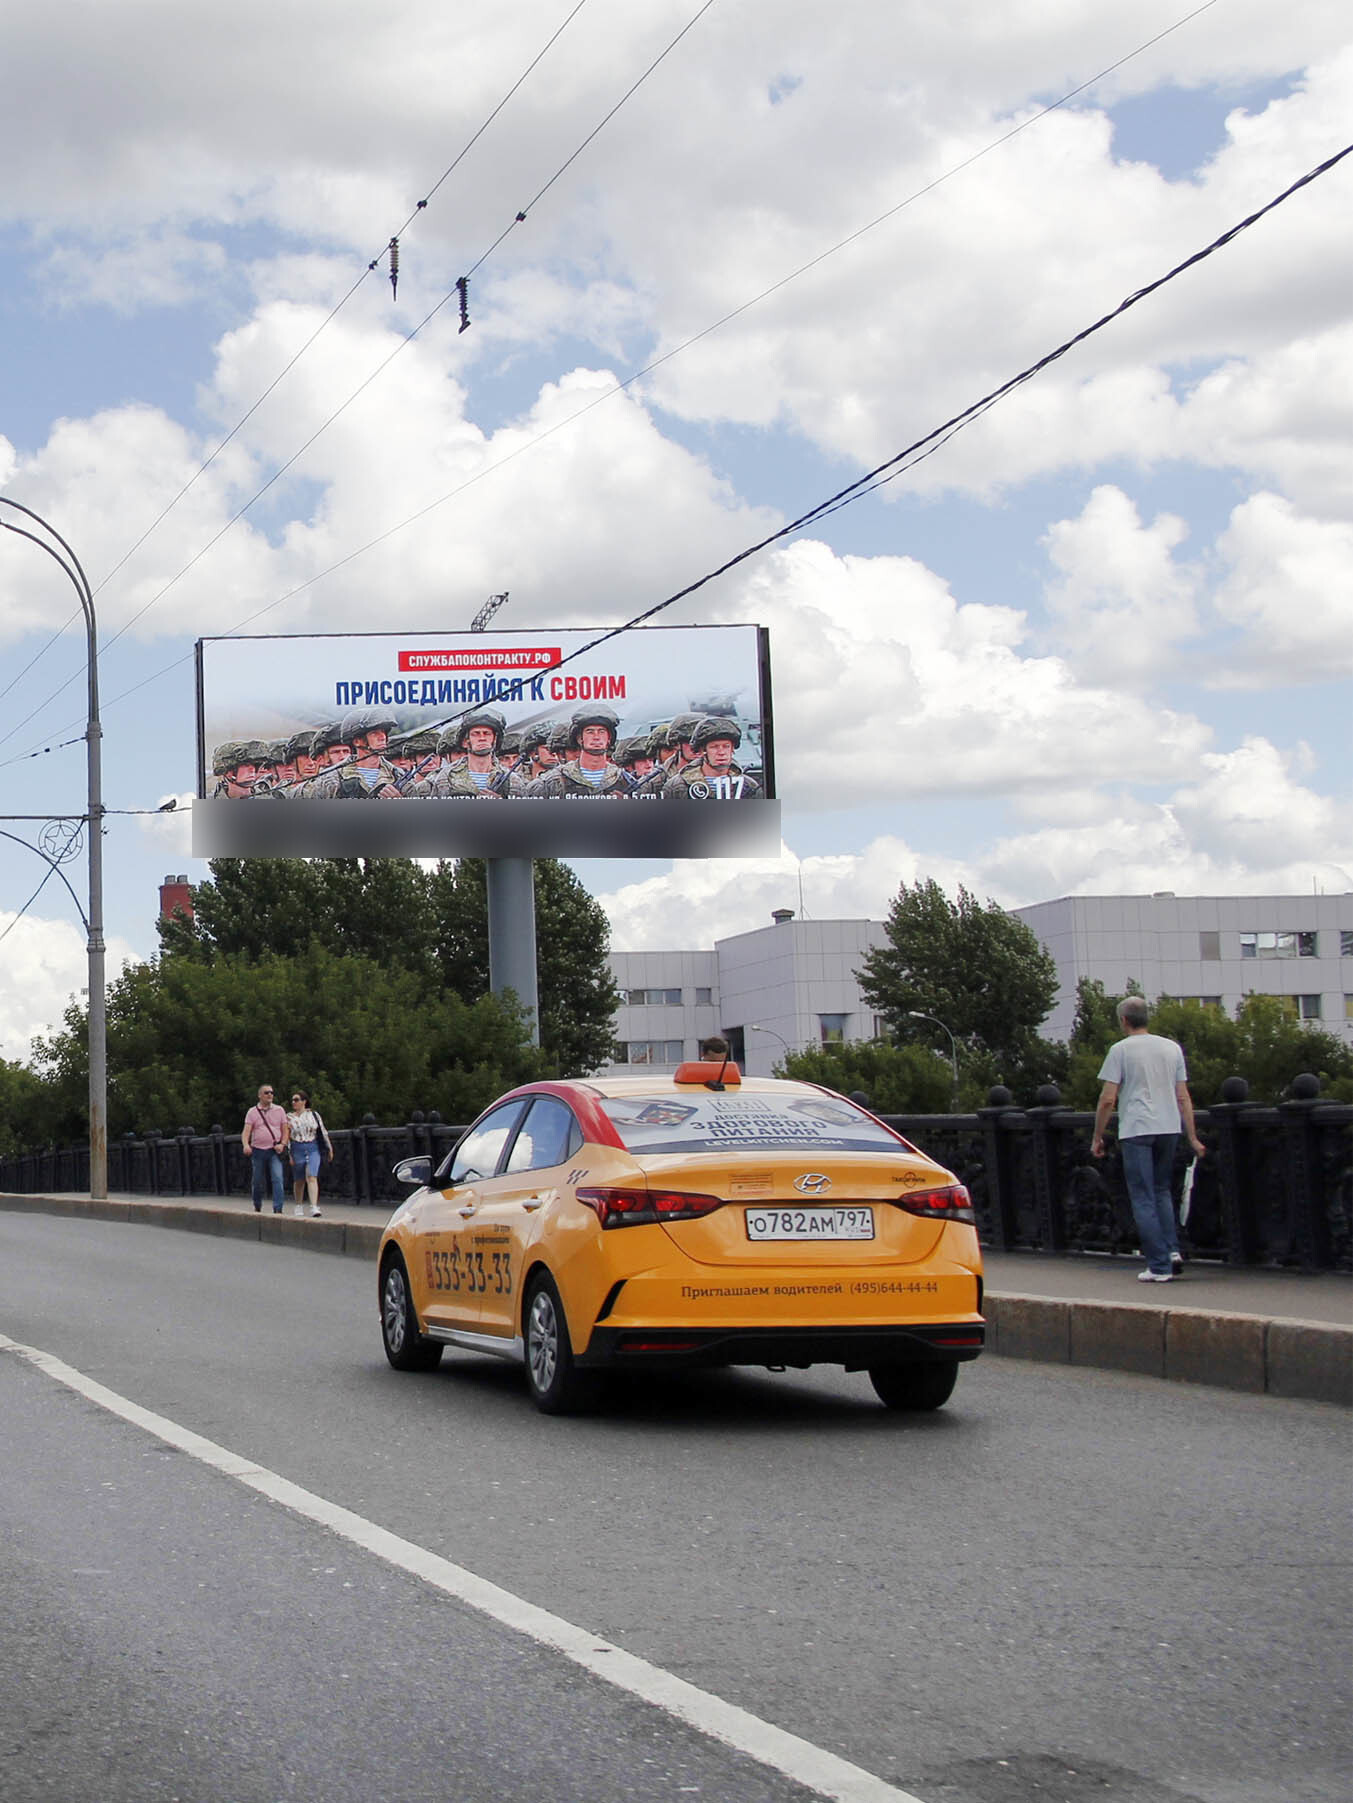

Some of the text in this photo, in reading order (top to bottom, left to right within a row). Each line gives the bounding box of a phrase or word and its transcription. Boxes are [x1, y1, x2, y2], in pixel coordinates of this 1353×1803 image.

[408, 652, 551, 668] СЛУЖБАПОКОНТРАКТУ.РФ
[336, 673, 626, 706] ПРИСОЕДИНЯЙСЯ К СВОИМ
[690, 1120, 827, 1130] ЗДОРОВОГО
[711, 1128, 821, 1137] ПИТАНИЯ
[704, 1138, 844, 1146] LEVELKITCHEN.COM
[753, 1211, 867, 1233] О782АМ 797
[681, 1282, 938, 1299] Приглашаем водителей (495)644-44-44
